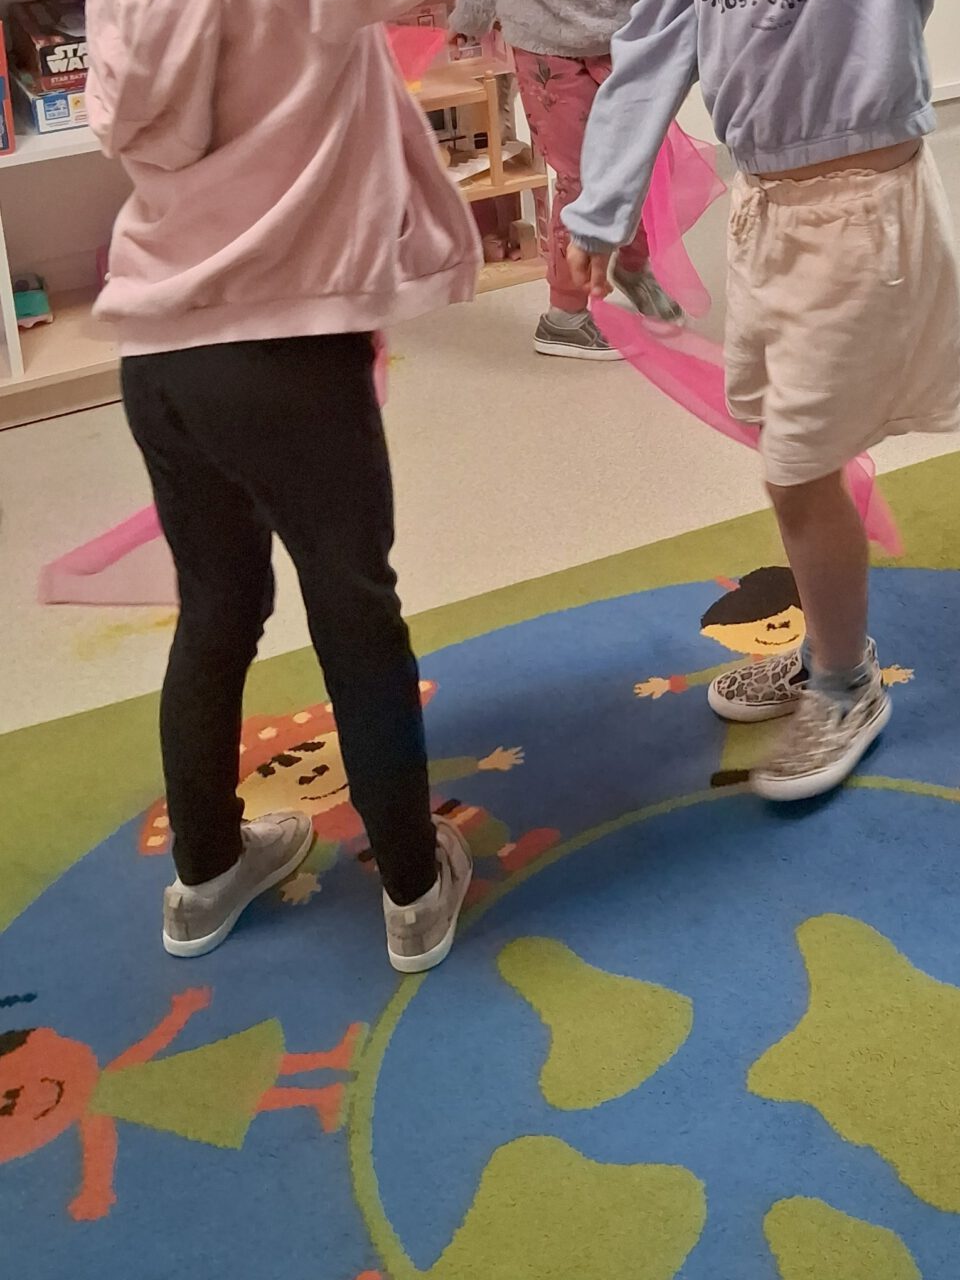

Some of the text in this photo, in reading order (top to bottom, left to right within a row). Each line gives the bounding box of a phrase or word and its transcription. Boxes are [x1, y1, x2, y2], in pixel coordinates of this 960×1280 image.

[46, 42, 88, 61] STA
[47, 56, 88, 74] WA
[69, 72, 87, 81] BATT
